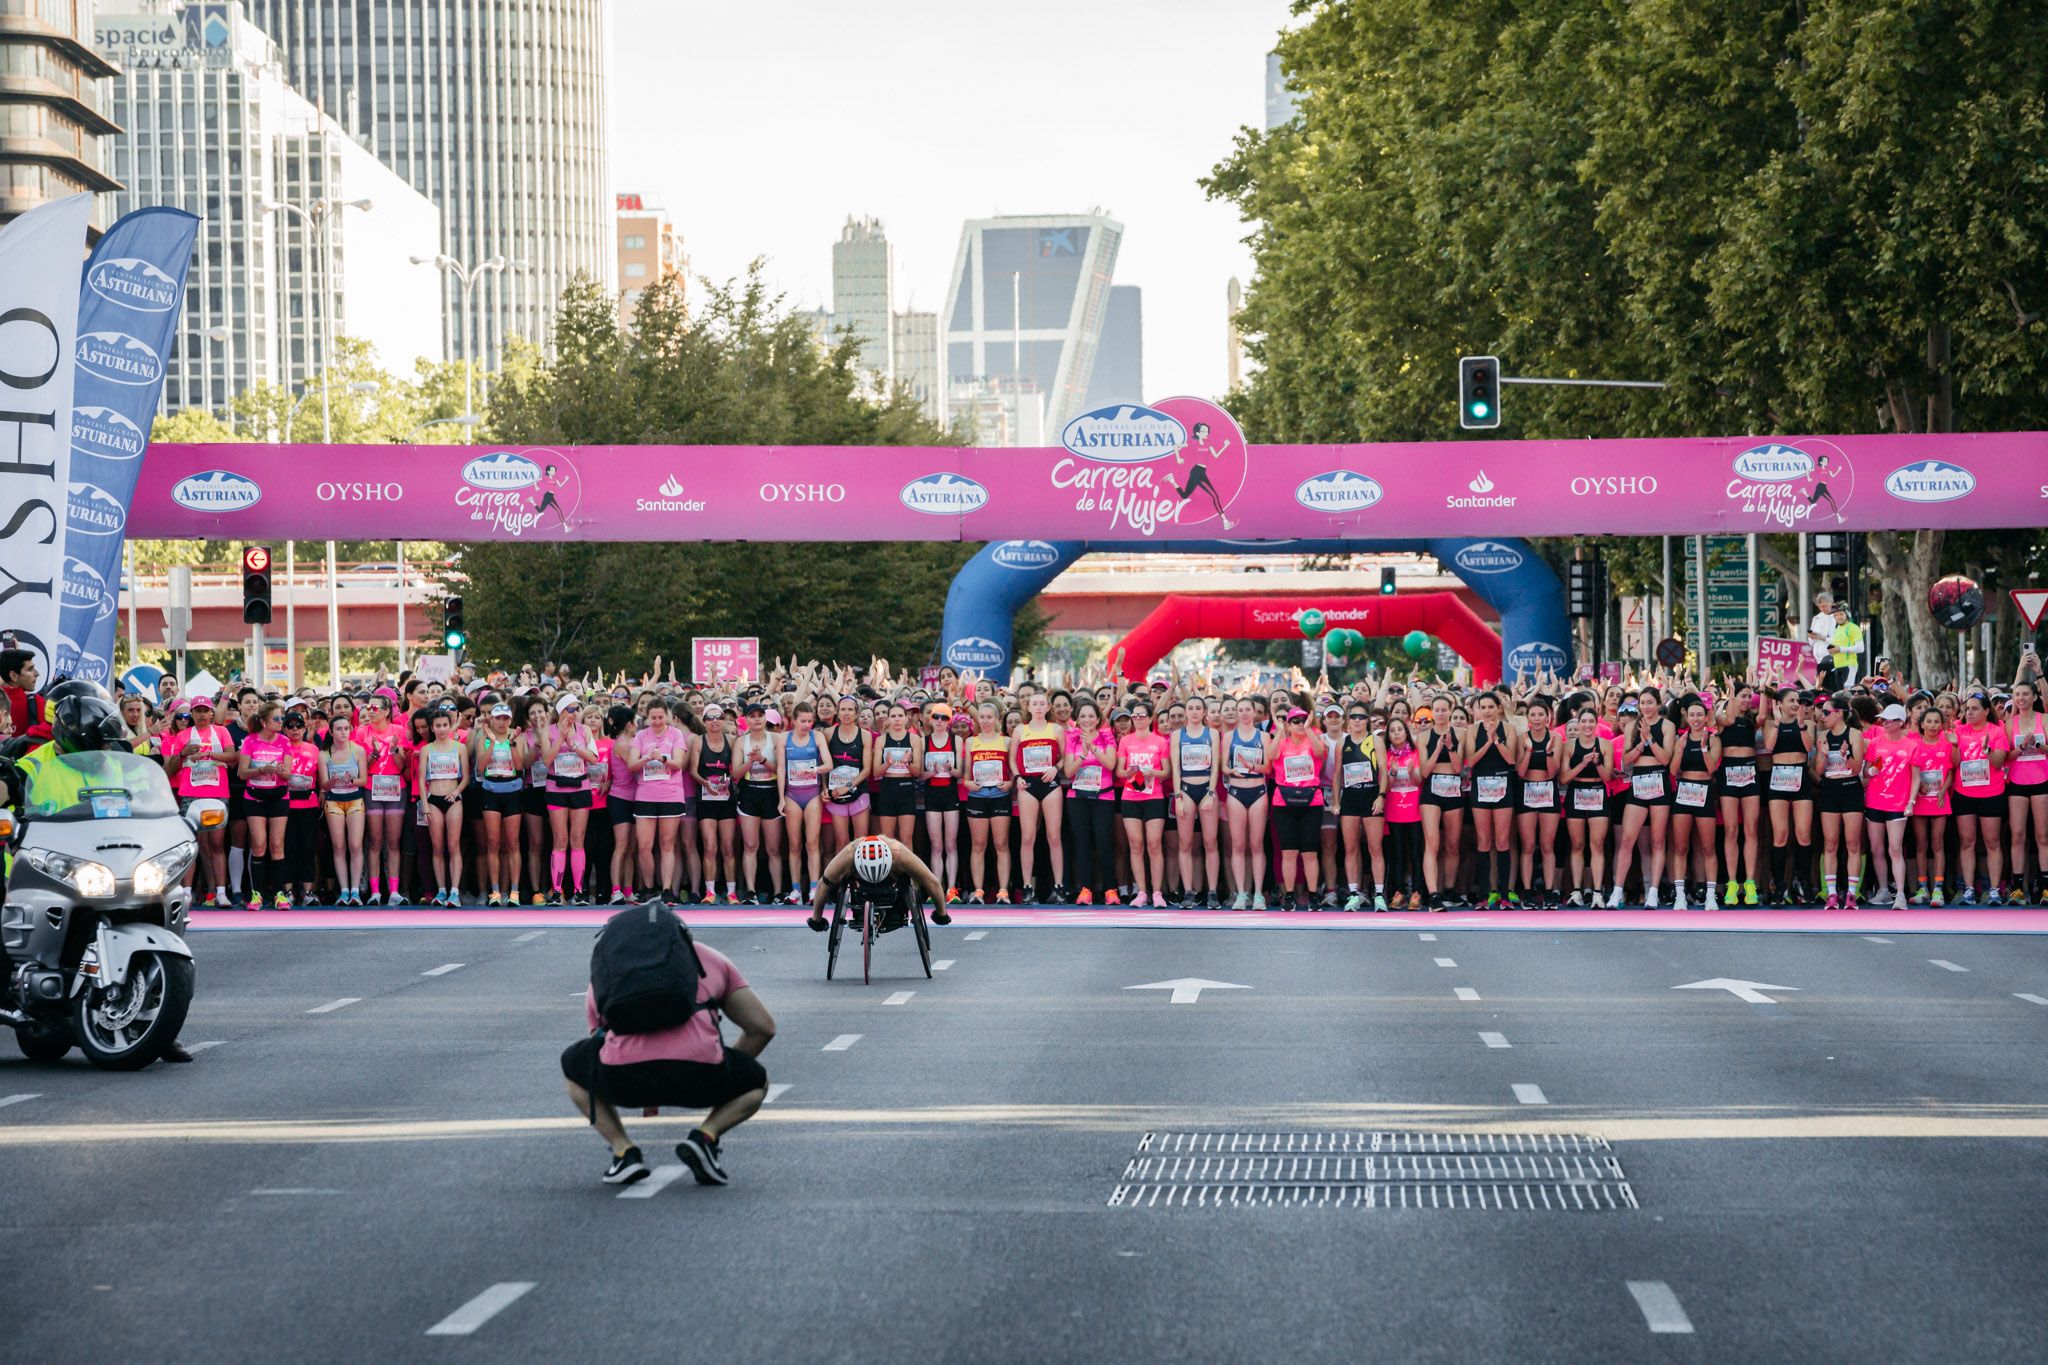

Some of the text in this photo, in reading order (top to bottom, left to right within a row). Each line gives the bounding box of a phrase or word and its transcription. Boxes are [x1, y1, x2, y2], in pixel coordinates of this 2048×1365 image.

[95, 21, 171, 48] spacio
[93, 268, 173, 305] ASTURIANA
[76, 341, 154, 379] ASTURIANA
[72, 425, 137, 453] STURIANA
[1072, 425, 1176, 447] ASTURIANA
[469, 465, 535, 480] ASTURIANA
[1051, 458, 1154, 489] Carrera
[1740, 458, 1807, 472] ASTURIANA
[180, 485, 254, 501] ASTURIANA
[316, 482, 403, 501] OYSHO
[759, 483, 845, 502] OYSHO
[1303, 485, 1376, 502] ASTURIANA
[1571, 476, 1657, 495] OYSHO
[1726, 478, 1793, 499] Carrera
[1893, 476, 1968, 492] ASTURIANA
[455, 486, 521, 507] Carrera
[636, 498, 706, 512] Santander
[908, 487, 981, 504] ASTURIANA
[1447, 495, 1517, 508] Santander
[68, 505, 119, 529] URIANA
[471, 504, 544, 536] de la Mujer
[1076, 485, 1191, 536] de la Mujer
[1742, 496, 1817, 527] de la Mujer
[998, 548, 1053, 562] ASTURIANA
[1461, 553, 1518, 566] ASTURIANA
[1710, 569, 1748, 578] Argentin
[62, 580, 99, 602] RIANA
[1253, 609, 1290, 624] Sports
[1323, 608, 1370, 621] ntander
[1709, 616, 1748, 624] Villaverd
[703, 644, 732, 657] SUB
[1761, 641, 1791, 656] SUB
